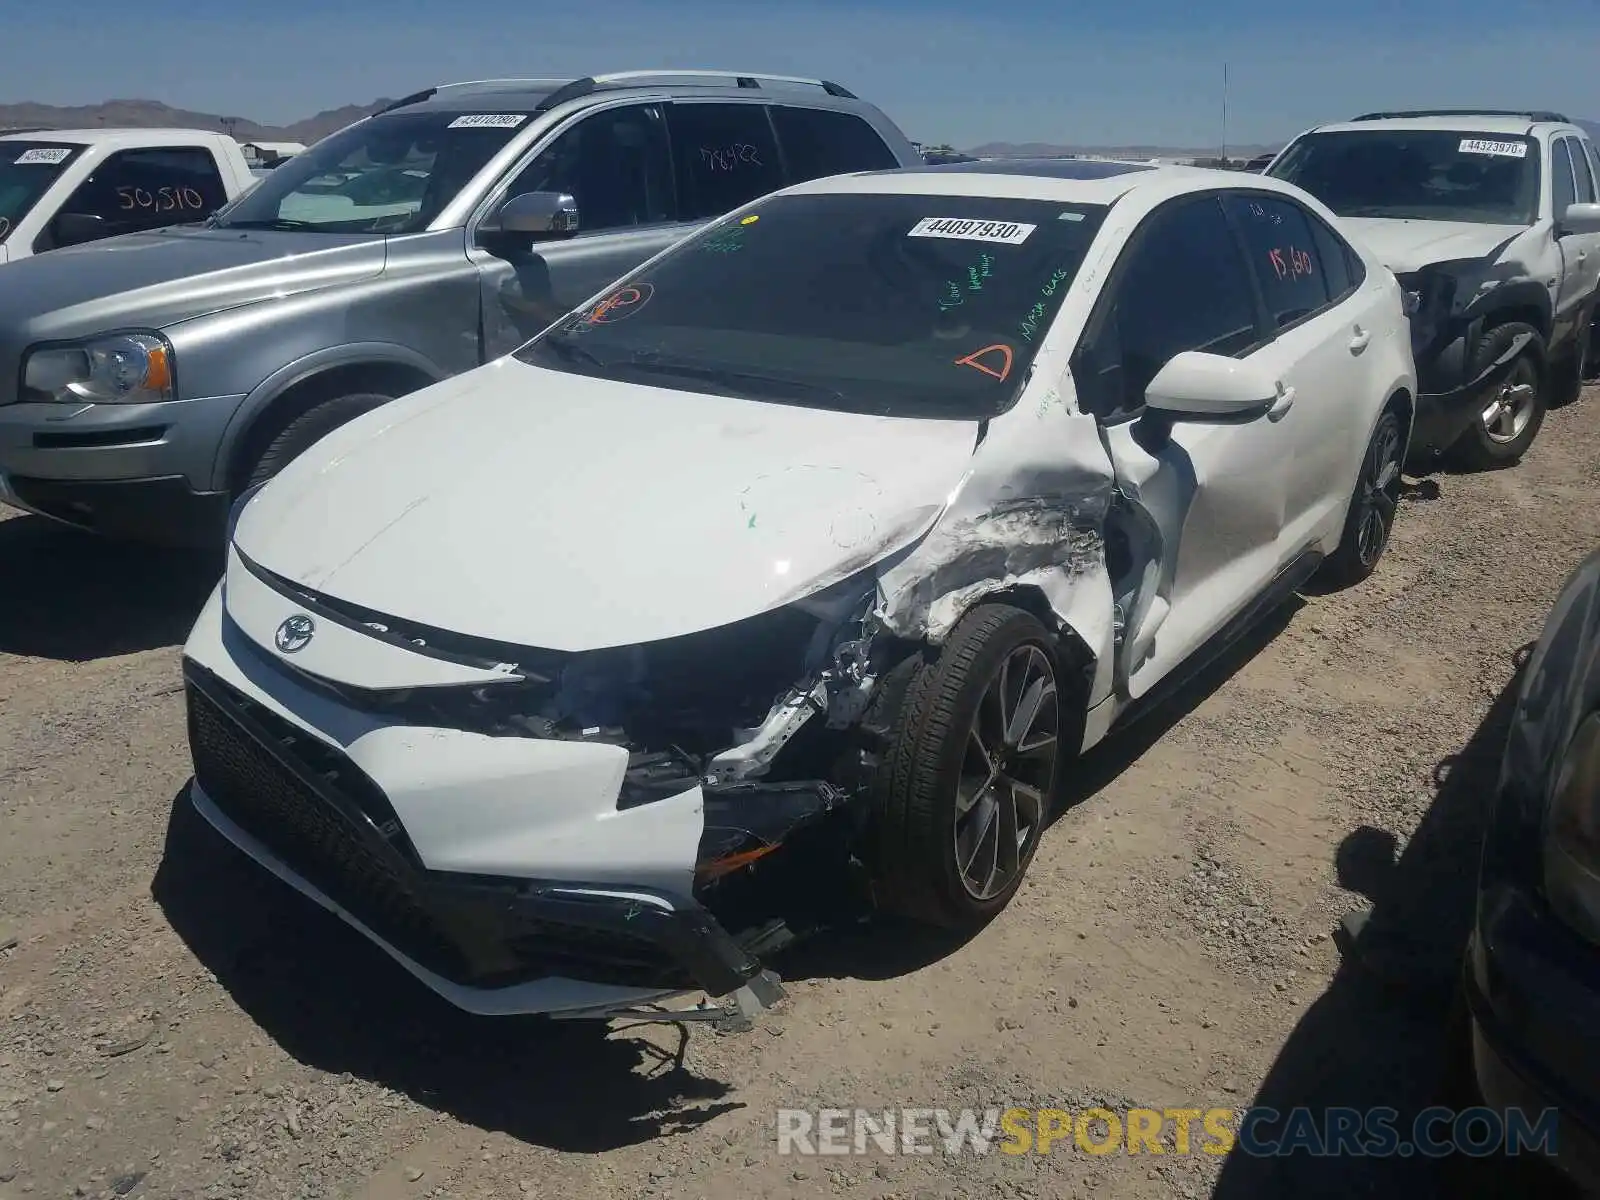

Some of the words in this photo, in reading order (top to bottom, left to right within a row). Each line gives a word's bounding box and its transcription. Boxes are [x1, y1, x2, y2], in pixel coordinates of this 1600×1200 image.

[116, 186, 203, 213] 50,510
[927, 219, 1018, 239] 44097930
[954, 344, 1013, 383] D
